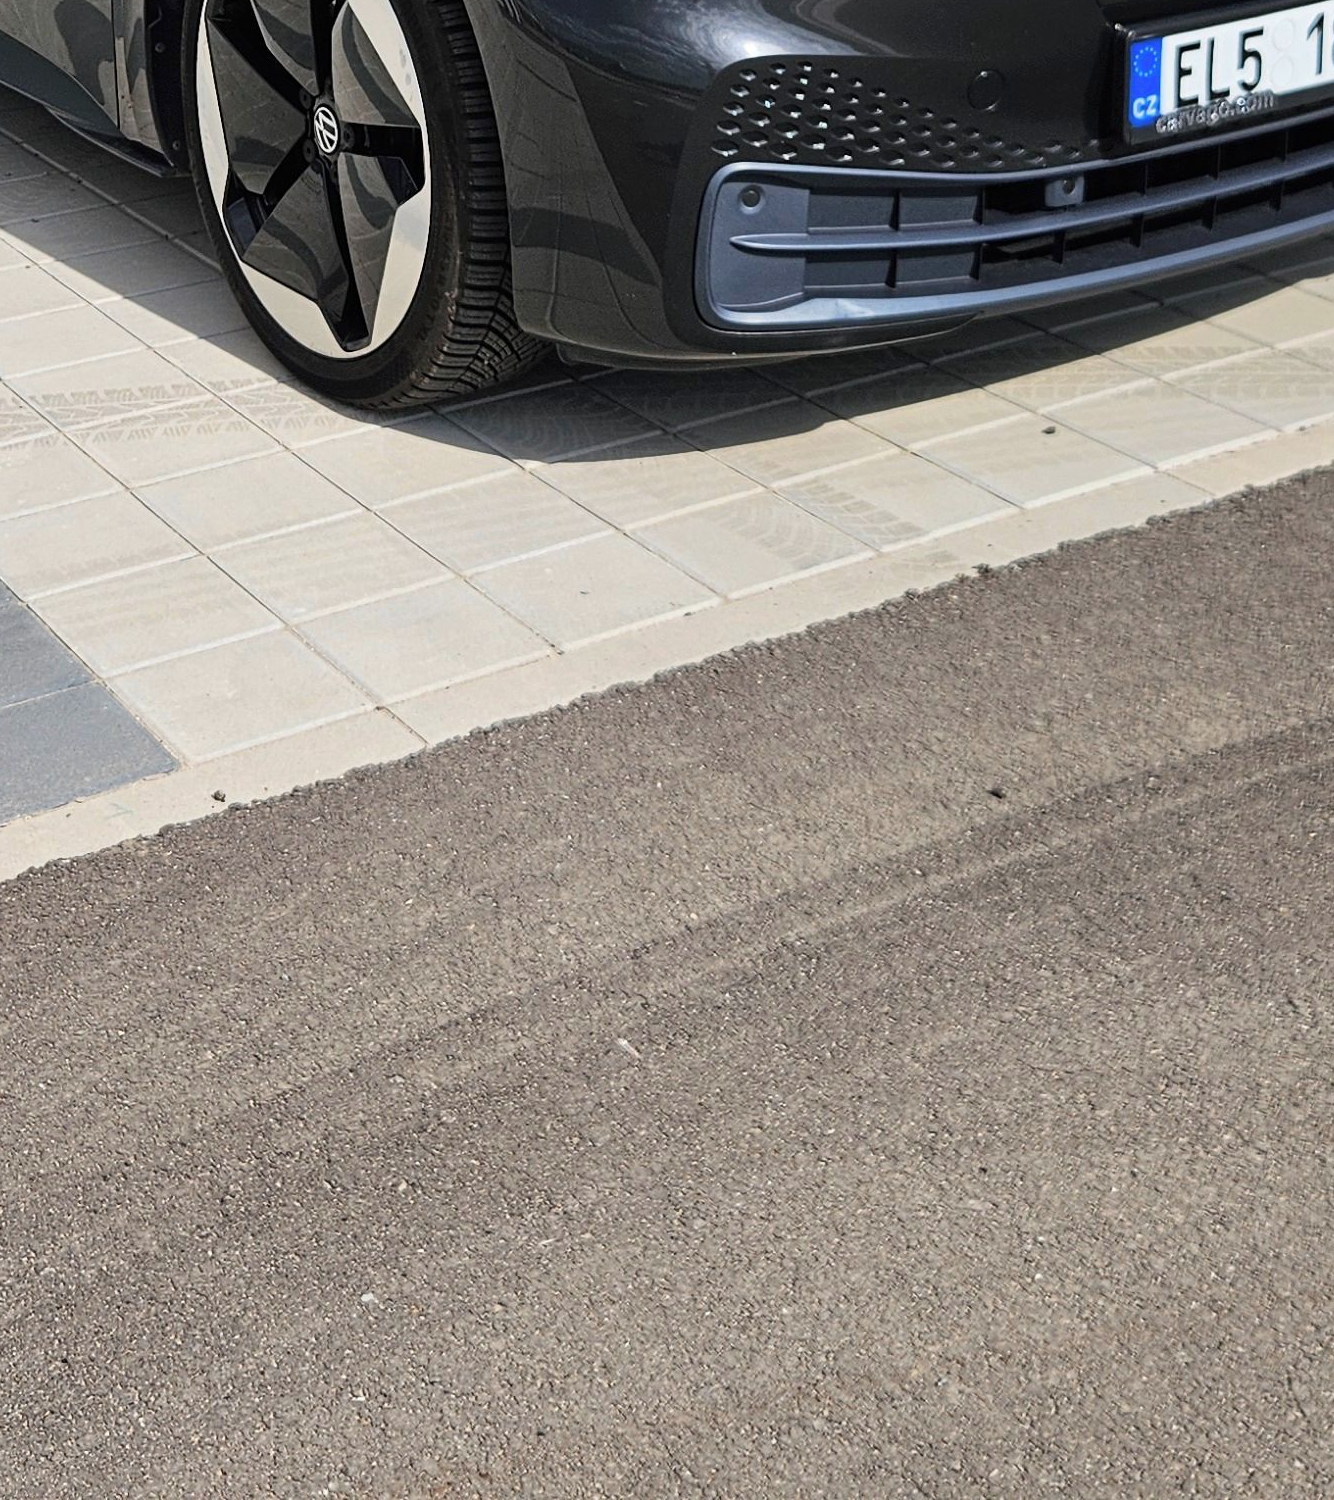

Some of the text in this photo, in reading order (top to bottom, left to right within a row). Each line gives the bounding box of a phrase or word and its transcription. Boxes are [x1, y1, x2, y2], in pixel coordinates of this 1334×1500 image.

[1174, 25, 1265, 109] EL5
[1132, 94, 1158, 120] CZ
[1155, 89, 1276, 134] carvago.com
